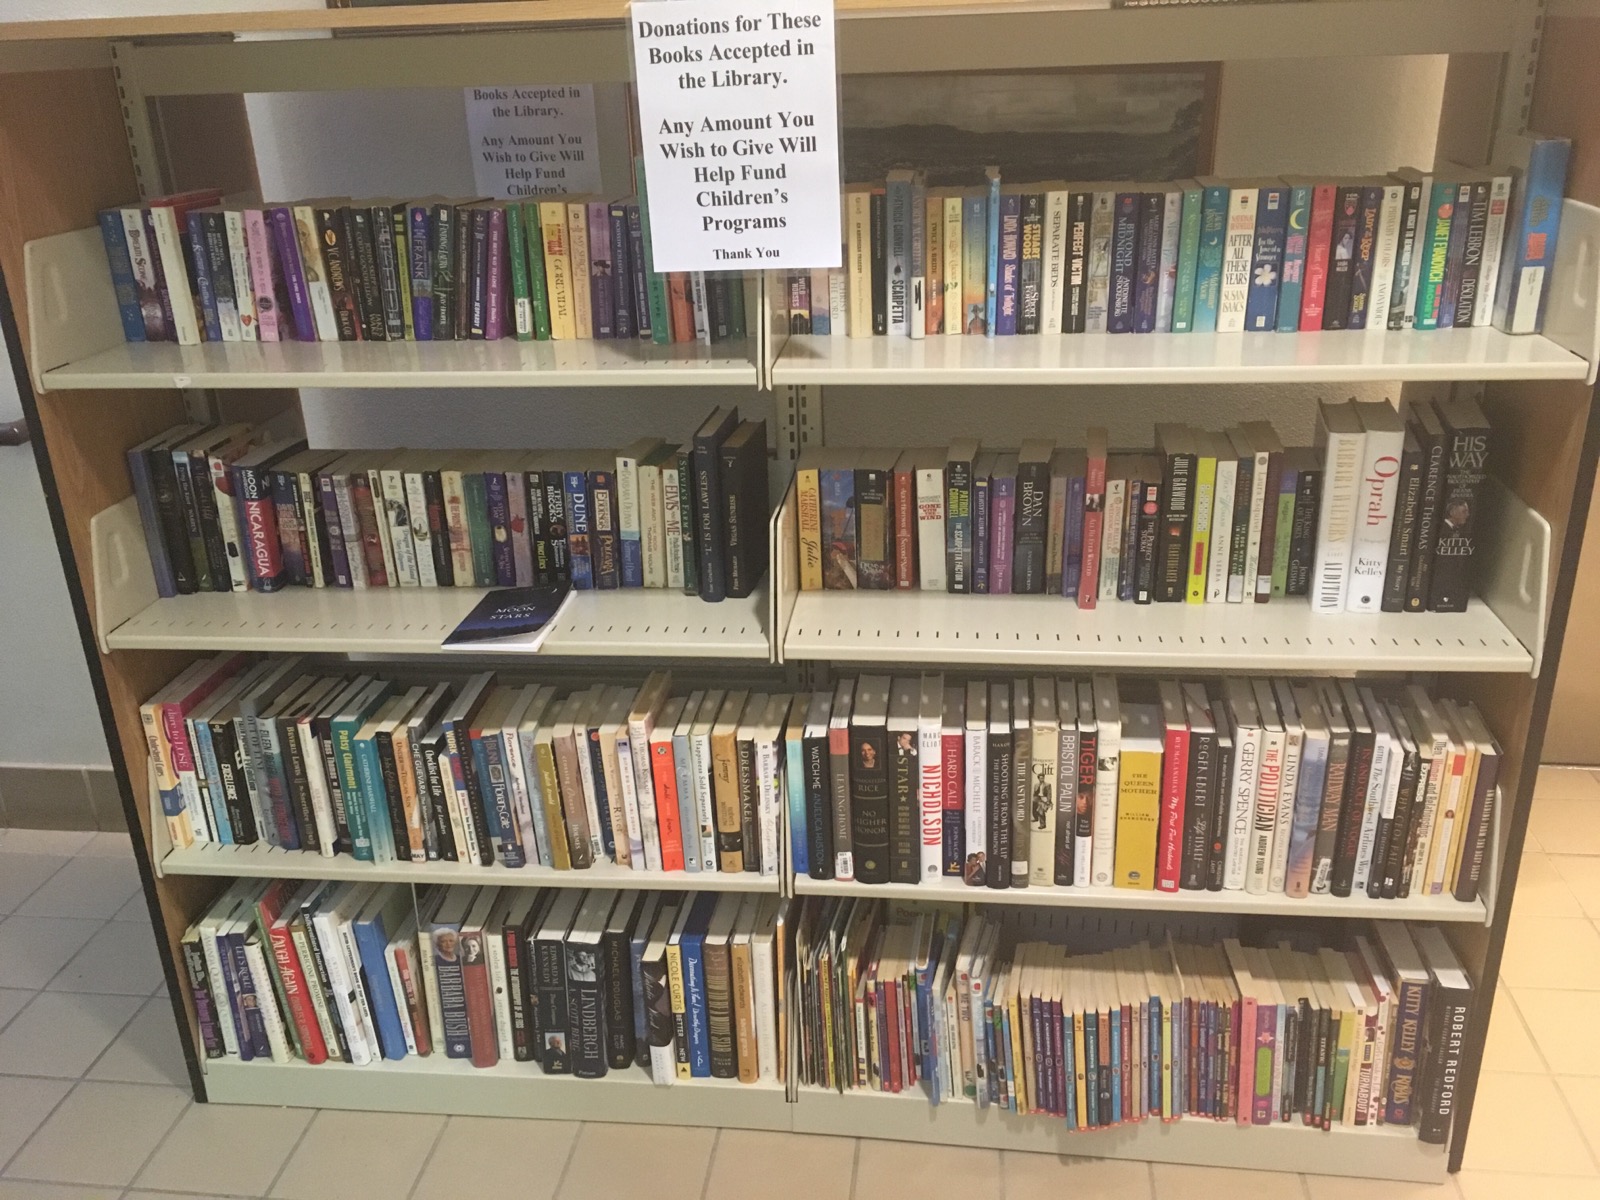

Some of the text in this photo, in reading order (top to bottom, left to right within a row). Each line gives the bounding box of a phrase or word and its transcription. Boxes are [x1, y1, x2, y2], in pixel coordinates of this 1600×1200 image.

[638, 12, 821, 39] Donations for These
[649, 39, 814, 64] Books Accepted in
[473, 87, 580, 101] Books Accepted in
[679, 69, 787, 89] the Library.
[492, 105, 563, 117] the Library.
[659, 112, 815, 137] Any Amount You
[481, 133, 582, 147] Any Amount You
[483, 150, 584, 163] Wish to Give Will
[660, 136, 817, 158] Wish to Give Will
[505, 167, 566, 180] Help Fund
[694, 164, 786, 186] Help Fund
[697, 188, 788, 207] Children's
[702, 215, 787, 234] Programs
[1023, 224, 1031, 260] WOODS
[1032, 224, 1041, 259] STUART
[1115, 217, 1127, 273] MIDNIGHT
[1124, 224, 1134, 266] BEYOND
[1228, 234, 1252, 247] AFTER
[1464, 200, 1487, 266] TIM LEBBON
[414, 239, 424, 279] FRANK
[713, 247, 780, 260] Thank You
[1051, 210, 1061, 288] SEPARATE BEDS
[1071, 222, 1084, 285] PERFECT VICTIM
[1226, 260, 1248, 272] THESE
[1233, 247, 1244, 259] ALL
[1429, 218, 1451, 282] JANET EVANOVICH
[553, 259, 567, 319] GORE VIDAL
[1224, 290, 1244, 300] SUSAN
[1225, 273, 1247, 285] YEARS
[1457, 279, 1476, 323] DESOLATION
[892, 280, 904, 324] SCARPETTA
[1450, 452, 1489, 468] WAY
[1453, 436, 1487, 451] HIS
[245, 470, 259, 499] MOON
[546, 486, 557, 523] BROOKS
[555, 489, 563, 520] TERRY
[949, 488, 959, 518] CORNWELL
[959, 490, 969, 517] PATRICIA
[1022, 482, 1033, 526] BROWN
[1032, 491, 1044, 517] DAN
[1170, 457, 1189, 511] JULIE GARWOOD
[1365, 456, 1400, 526] Oprah
[1418, 445, 1443, 550] CLARENCE THOMAS
[573, 493, 587, 532] DUNE
[665, 485, 680, 536] ELVIS ME
[800, 490, 810, 532] MARSHALL
[809, 488, 818, 533] CATHERINE
[1398, 477, 1420, 556] Elizabeth Smart
[247, 502, 270, 575] NICARAGUA
[801, 537, 818, 568] Julie
[954, 530, 964, 581] SCARPETTA FACTOR
[1439, 538, 1472, 546] KITTY
[1354, 566, 1383, 577] Kelley
[1358, 557, 1382, 567] Kitty
[1319, 561, 1343, 609] AUDITION
[496, 606, 535, 614] MOON
[167, 709, 188, 768] dare to LOSE
[446, 731, 458, 755] WORK
[411, 743, 426, 795] CHE GUEVARA
[897, 757, 908, 793] STAR
[947, 749, 957, 807] HARD CALL
[973, 736, 981, 813] BARACK MICHELLE
[1001, 753, 1009, 799] SHOOTING
[1059, 735, 1075, 812] BRISTOL PALIN
[1080, 737, 1096, 785] TIGER
[740, 751, 752, 823] DRESSMAKER
[811, 746, 824, 865] WATCH ME ANJELICA HUSTON
[922, 765, 942, 846] NICHOLSON
[1017, 762, 1026, 821] THE LAST WORD
[1234, 742, 1255, 835] GERRY SPENCE
[1280, 754, 1297, 825] LINDA EVANS
[1321, 763, 1347, 832] RAILWAY MAN
[1419, 741, 1447, 838] Men, Women and Relationships
[1254, 749, 1280, 874] THE POLITICIAN ANDREW YOUNG
[1355, 767, 1382, 876] The Southwest Airlines Way
[269, 934, 299, 995] LAUGH AGAIN
[669, 952, 682, 1011] NICOLE CURTIS
[437, 965, 469, 1036] BARBARA BUSH
[1400, 985, 1422, 1054] KITTY KELLEY
[581, 989, 599, 1059] LINDBERGH
[1438, 1006, 1467, 1115] ROBERT REDFORD
[1356, 1067, 1372, 1113] TURNABOUT
